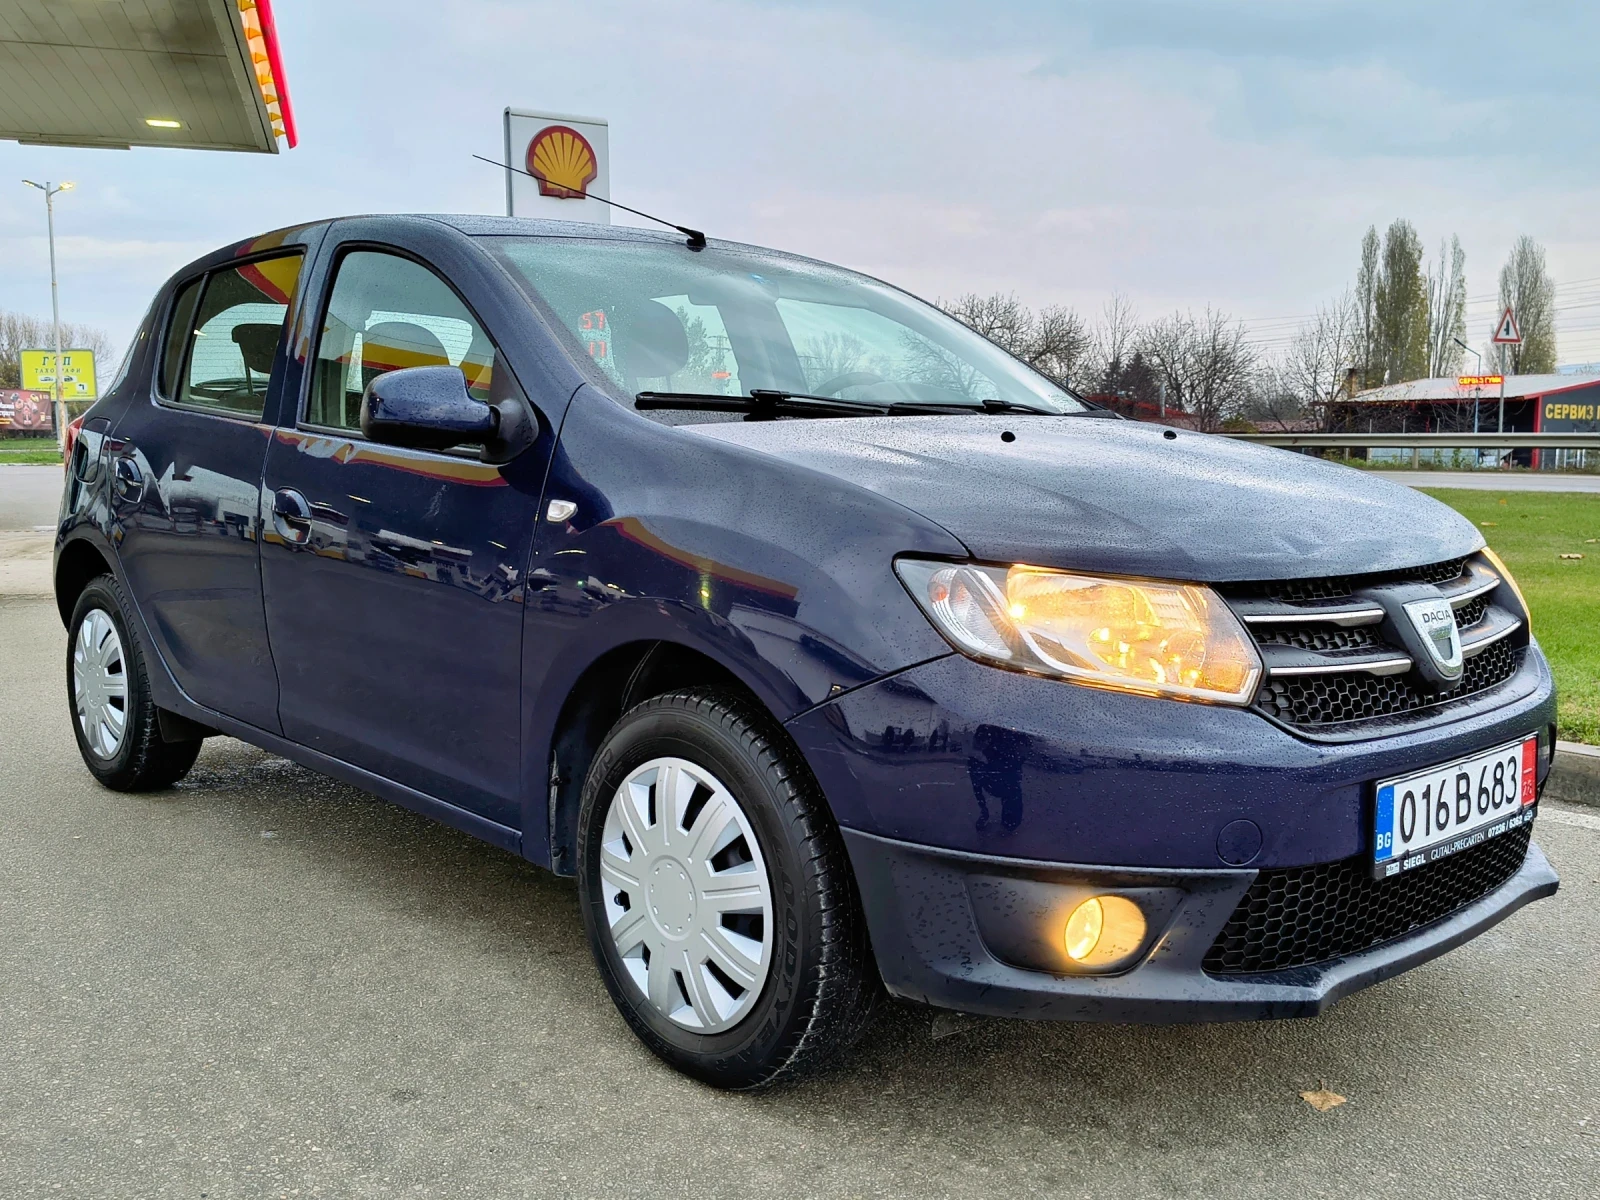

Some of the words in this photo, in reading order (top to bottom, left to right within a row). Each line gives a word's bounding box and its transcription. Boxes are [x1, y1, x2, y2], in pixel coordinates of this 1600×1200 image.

[1545, 403, 1594, 420] СЕРВИЗ
[1422, 609, 1451, 623] DACIA
[1400, 756, 1518, 844] 016B683
[1376, 831, 1392, 851] BG
[1403, 853, 1427, 871] SIEGL
